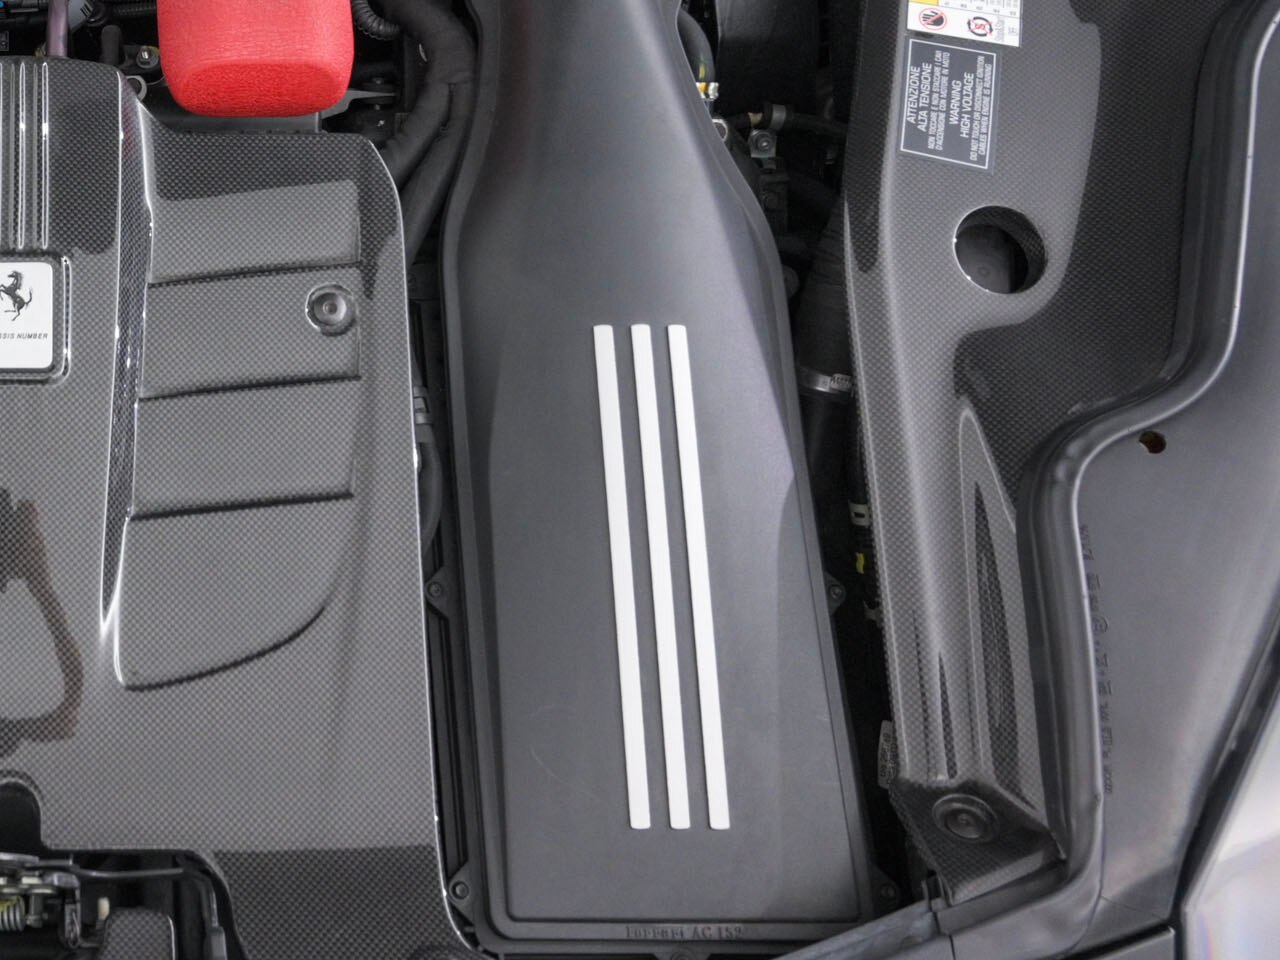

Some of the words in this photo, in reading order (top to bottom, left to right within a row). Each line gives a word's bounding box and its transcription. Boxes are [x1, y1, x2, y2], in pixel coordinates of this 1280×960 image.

[942, 52, 950, 67] MOTO
[907, 66, 920, 123] ATTENZIONE
[919, 63, 932, 107] TENSIONE
[961, 72, 974, 111] VOLTAGE
[949, 80, 962, 125] WARNING
[918, 110, 928, 132] ALTA
[960, 114, 971, 138] HIGH
[971, 121, 980, 138] TOUCH
[970, 152, 977, 161] DO
[971, 140, 979, 151] NOT
